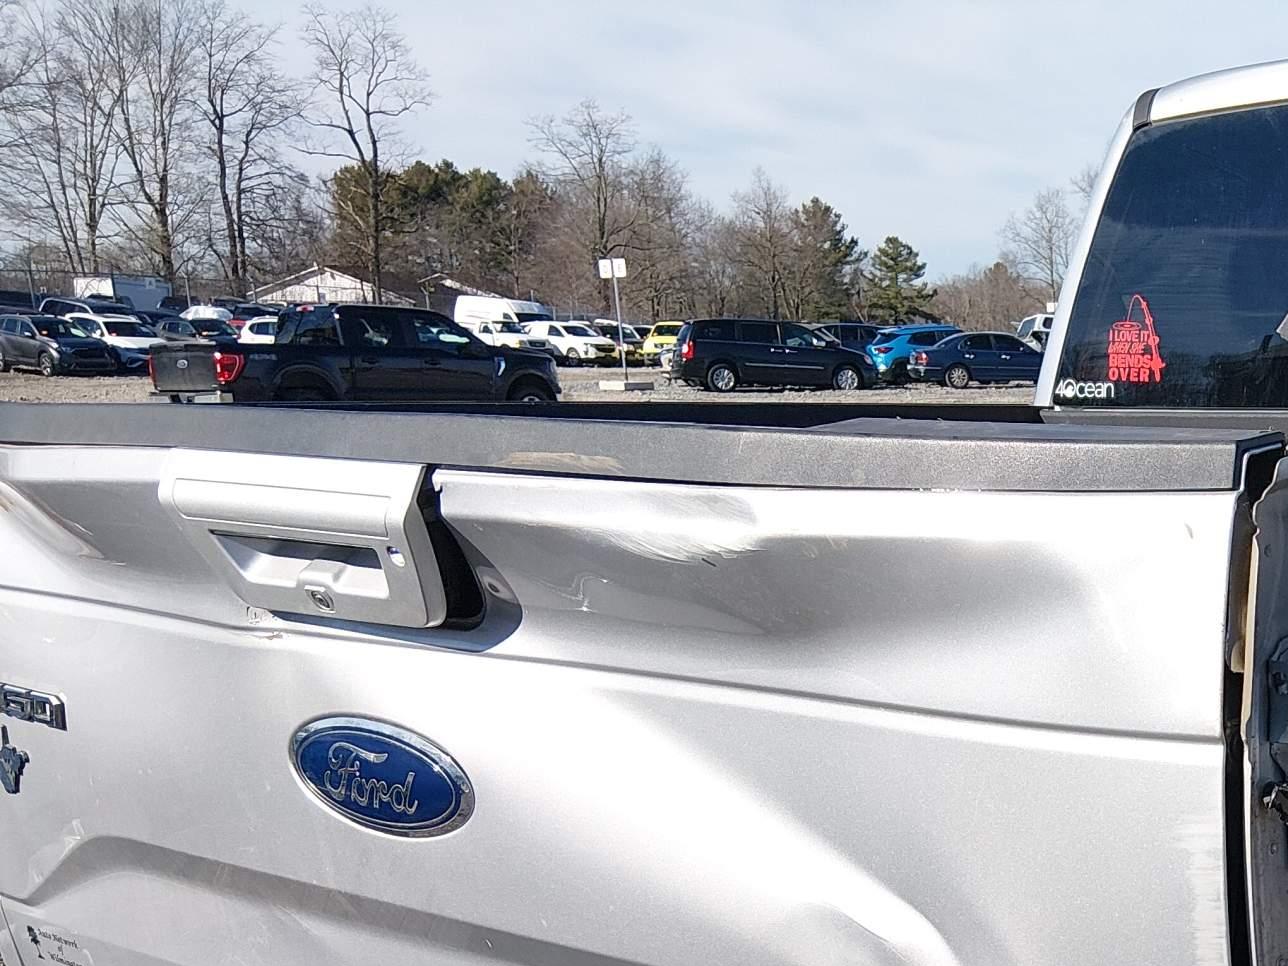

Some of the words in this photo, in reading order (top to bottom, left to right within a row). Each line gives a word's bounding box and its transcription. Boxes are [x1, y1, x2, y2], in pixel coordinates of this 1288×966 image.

[1109, 329, 1113, 341] I
[1115, 330, 1139, 341] LOVE
[1141, 330, 1149, 341] IT
[1109, 354, 1151, 368] BENDS
[1109, 367, 1150, 382] OVER
[323, 741, 419, 815] Ford
